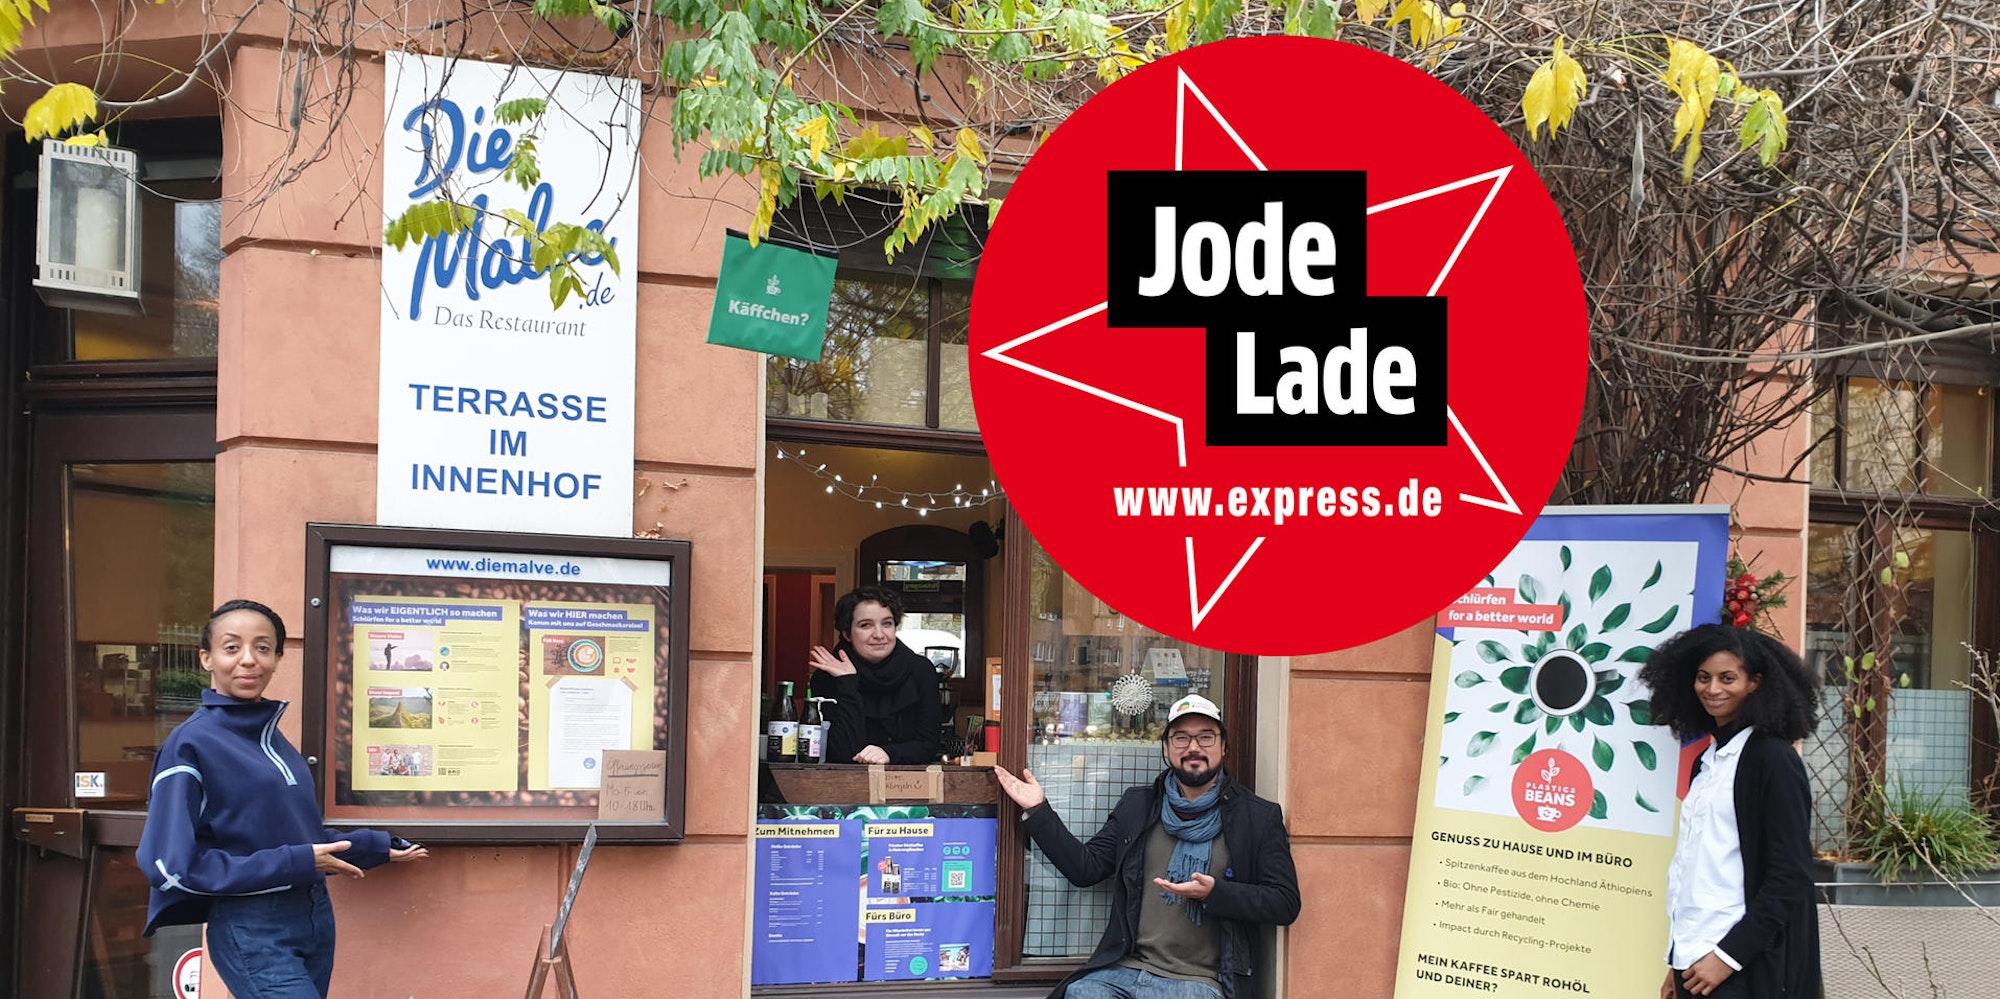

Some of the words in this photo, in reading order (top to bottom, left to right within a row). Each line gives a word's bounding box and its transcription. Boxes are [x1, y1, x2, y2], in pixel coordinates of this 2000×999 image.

[403, 98, 514, 198] Die
[409, 182, 618, 321] Male
[579, 272, 615, 309] .de
[434, 306, 474, 328] Das
[479, 310, 588, 337] Restaurant
[727, 299, 810, 327] Käffchen?
[409, 383, 607, 423] TERRASSE
[490, 429, 527, 457] IM
[412, 463, 602, 500] INNENHOF
[426, 557, 581, 577] www.diemalve.de
[352, 606, 372, 614] Was
[374, 606, 389, 614] wir
[390, 607, 448, 616] EIGENTLICH
[462, 609, 497, 617] machen
[528, 609, 547, 618] Was
[549, 610, 564, 618] wir
[565, 610, 587, 619] HIER
[588, 612, 623, 620] machen
[1448, 610, 1463, 621] for
[1465, 613, 1472, 621] a
[1475, 611, 1514, 623] better
[1517, 613, 1554, 625] world
[1525, 789, 1575, 807] BEANS
[778, 826, 835, 836] Mitnehmen
[868, 826, 884, 835] Für
[899, 826, 928, 835] Hause
[1431, 831, 1481, 847] GENUSS
[1483, 838, 1500, 849] ZU
[1502, 840, 1543, 856] HAUSE
[1546, 847, 1574, 860] UND
[1577, 851, 1592, 862] IM
[1596, 852, 1633, 868] BÜRO
[1445, 858, 1510, 876] Spitzenkaffee
[1510, 869, 1527, 879] aus
[1528, 870, 1549, 882] dem
[1550, 874, 1598, 889] Hochland
[1599, 878, 1653, 897] Äthiopiens
[1443, 879, 1461, 889] Bio:
[1462, 881, 1489, 894] Ohne
[1490, 886, 1534, 902] Pestizide,
[1535, 894, 1560, 906] ohne
[1561, 897, 1601, 911] Chemie
[866, 912, 887, 920] Fürs
[889, 911, 912, 920] Büro
[1441, 900, 1465, 912] Mehr
[1466, 904, 1480, 914] als
[1481, 906, 1500, 916] Fair
[1501, 909, 1546, 925] gehandelt
[1439, 920, 1471, 934] Impact
[1473, 926, 1500, 939] durch
[1502, 930, 1592, 954] Recycling-Projekte
[1416, 969, 1443, 983] UND
[1445, 974, 1499, 993] DEINER?
[1417, 953, 1449, 968] MEIN
[1450, 958, 1499, 977] KAFFEE
[1500, 967, 1541, 985] SPART
[1542, 976, 1591, 994] ROHÖL
